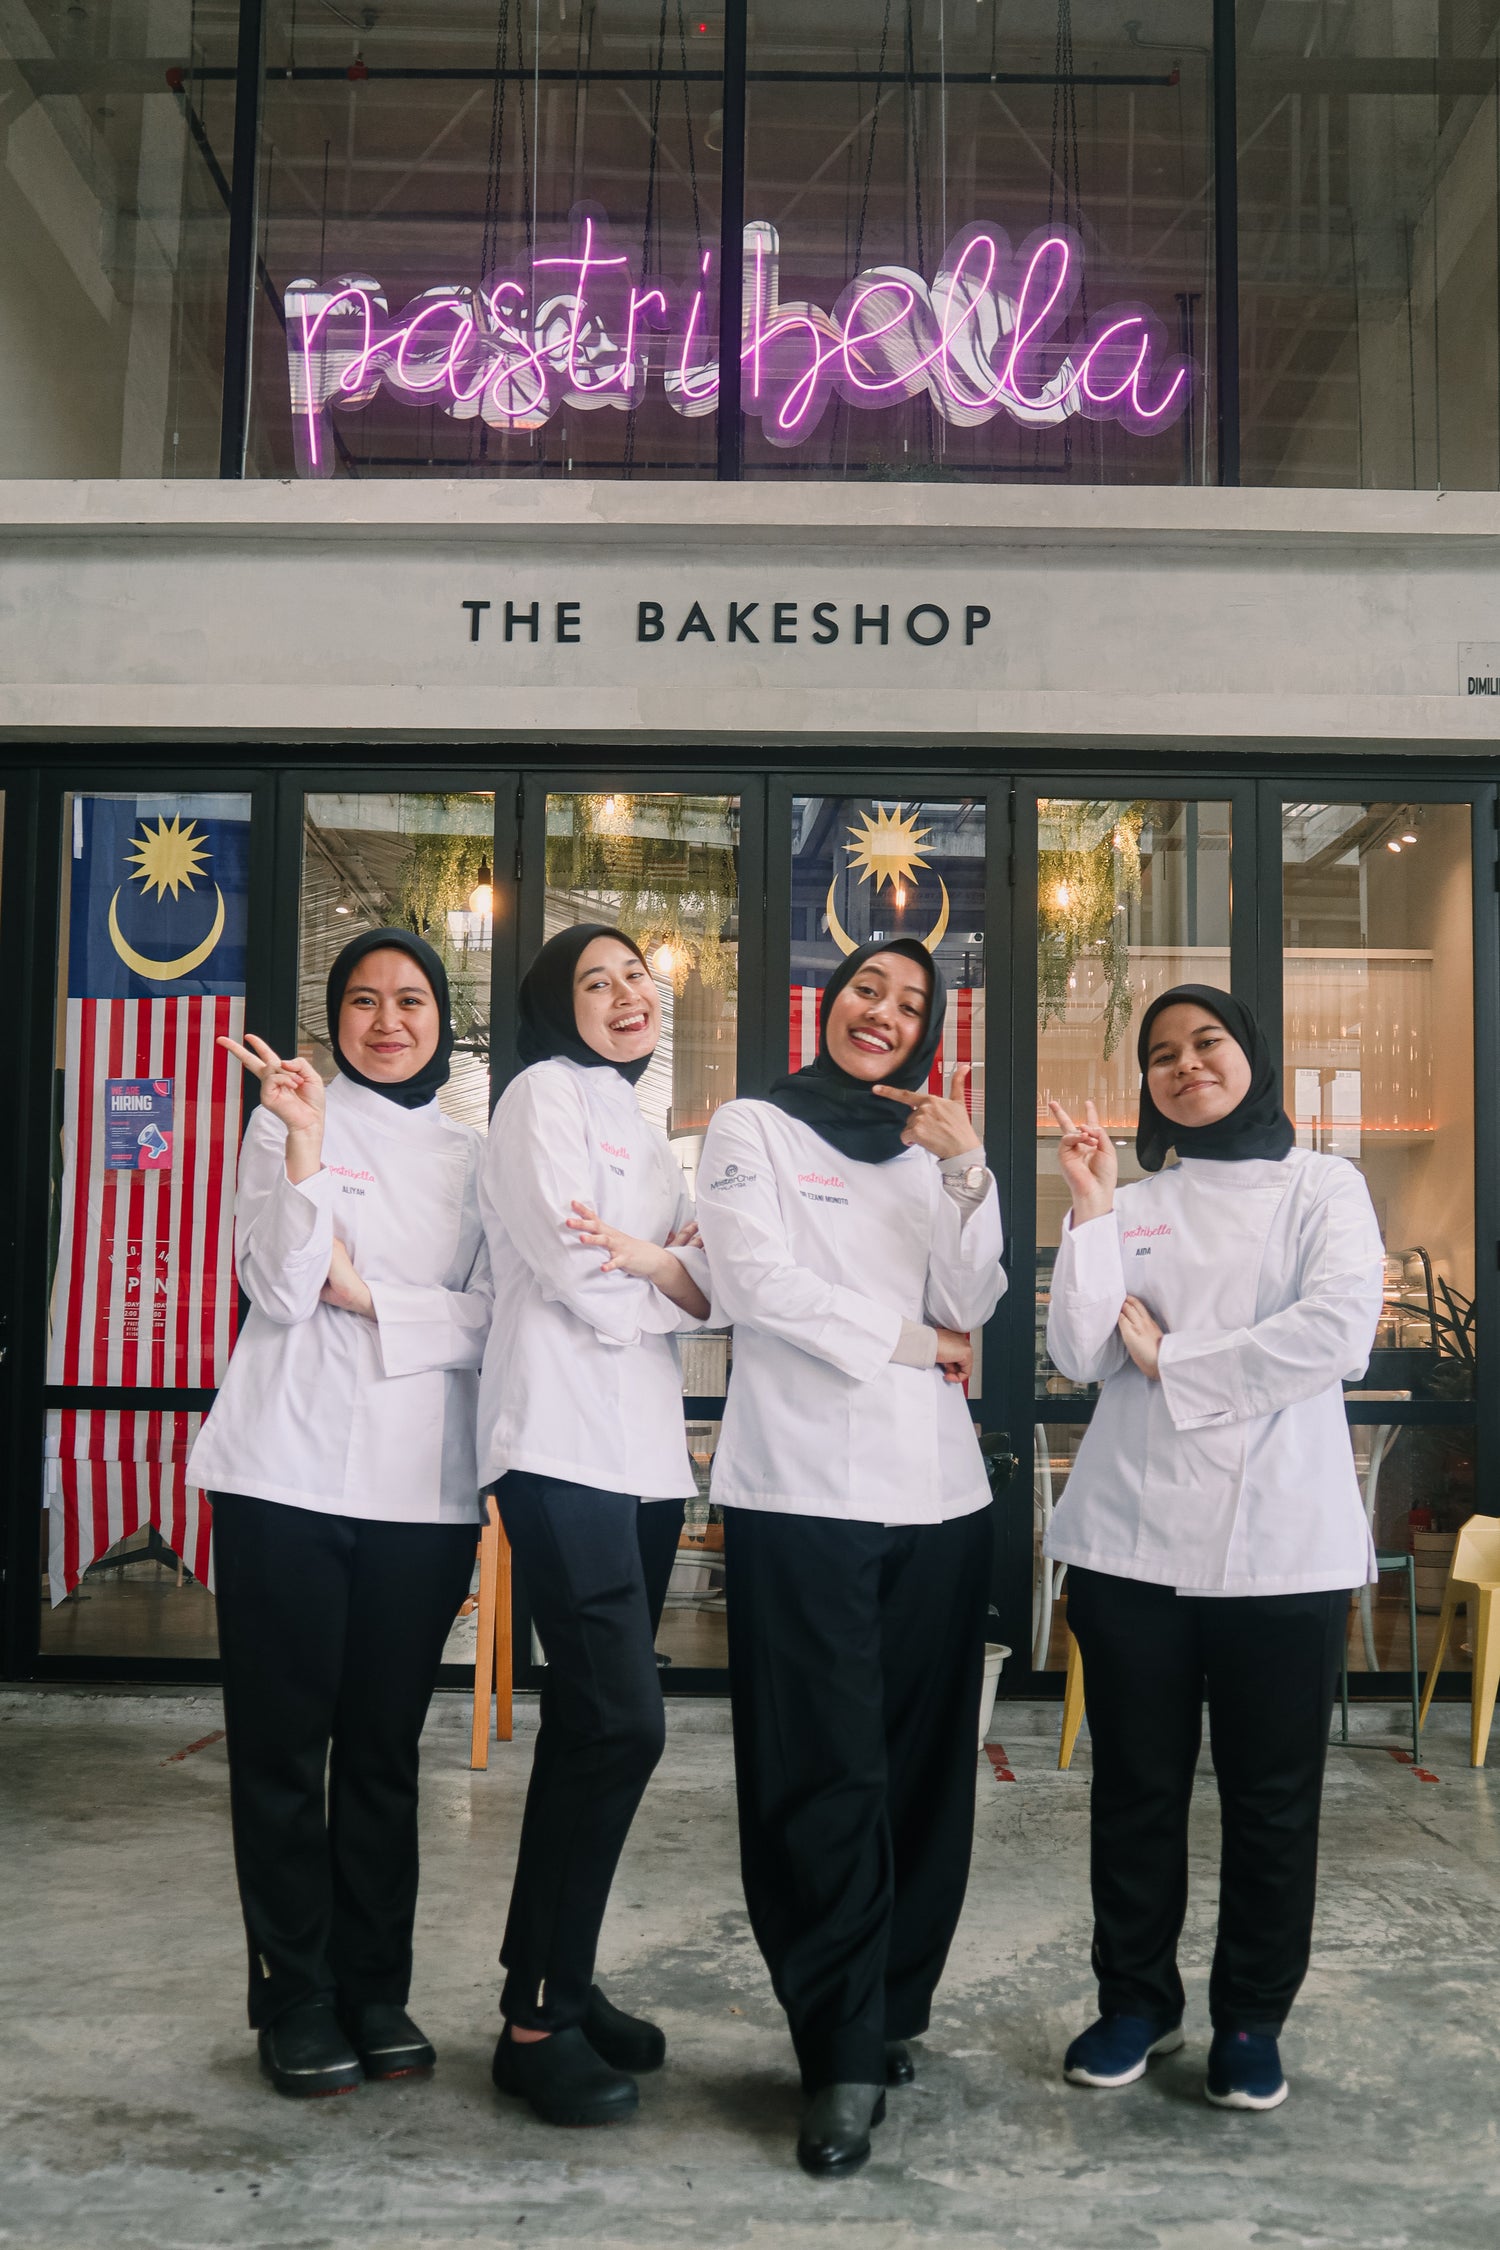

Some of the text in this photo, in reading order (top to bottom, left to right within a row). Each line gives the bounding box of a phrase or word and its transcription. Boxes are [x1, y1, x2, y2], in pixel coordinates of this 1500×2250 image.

[301, 216, 1187, 466] pastribella
[462, 601, 990, 645] THE BAKESHOP
[111, 1086, 140, 1095] WE ARE
[111, 1095, 153, 1111] HIRING
[710, 1174, 757, 1191] MasterChef
[797, 1172, 845, 1189] pastribella
[1122, 1223, 1172, 1244] pastribella
